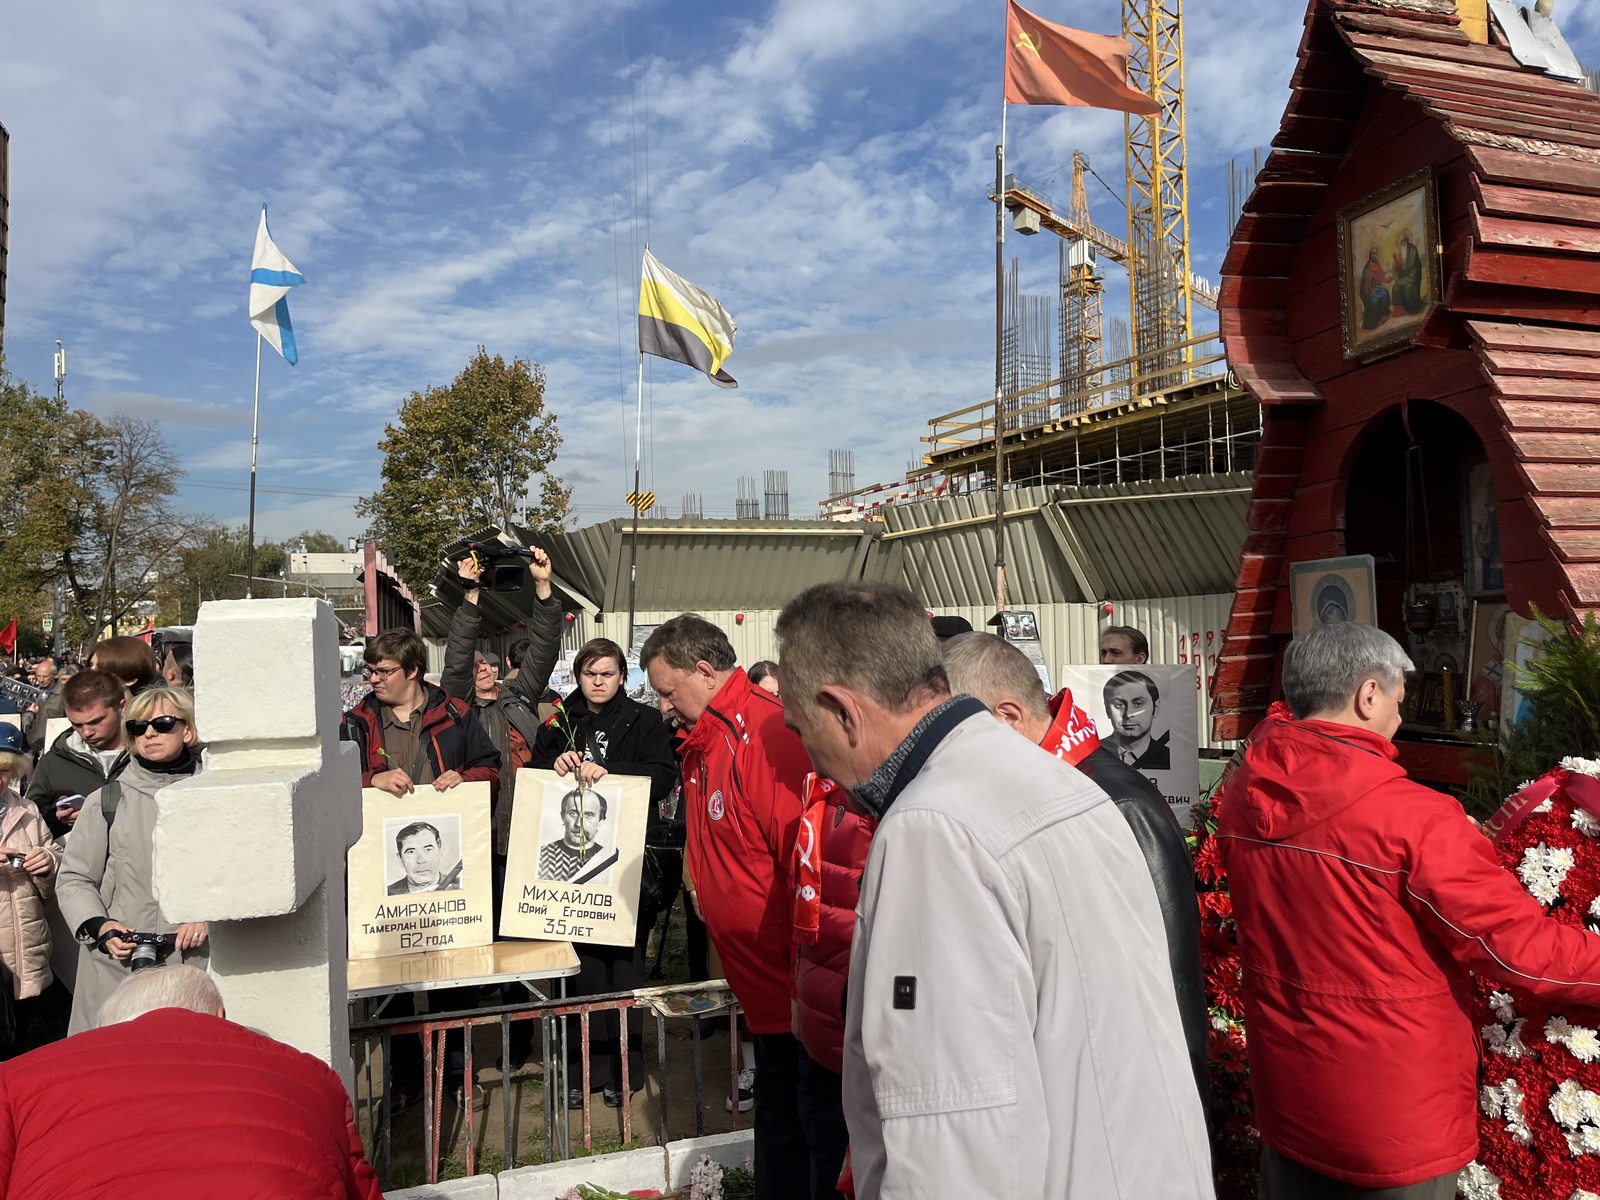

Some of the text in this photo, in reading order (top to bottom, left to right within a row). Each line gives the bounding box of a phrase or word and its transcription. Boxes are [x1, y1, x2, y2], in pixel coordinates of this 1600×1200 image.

[522, 884, 613, 907] МИХАЙЛОВ
[374, 899, 466, 919] АМИРХАНОВ
[543, 918, 567, 935] 35
[400, 932, 423, 949] 62
